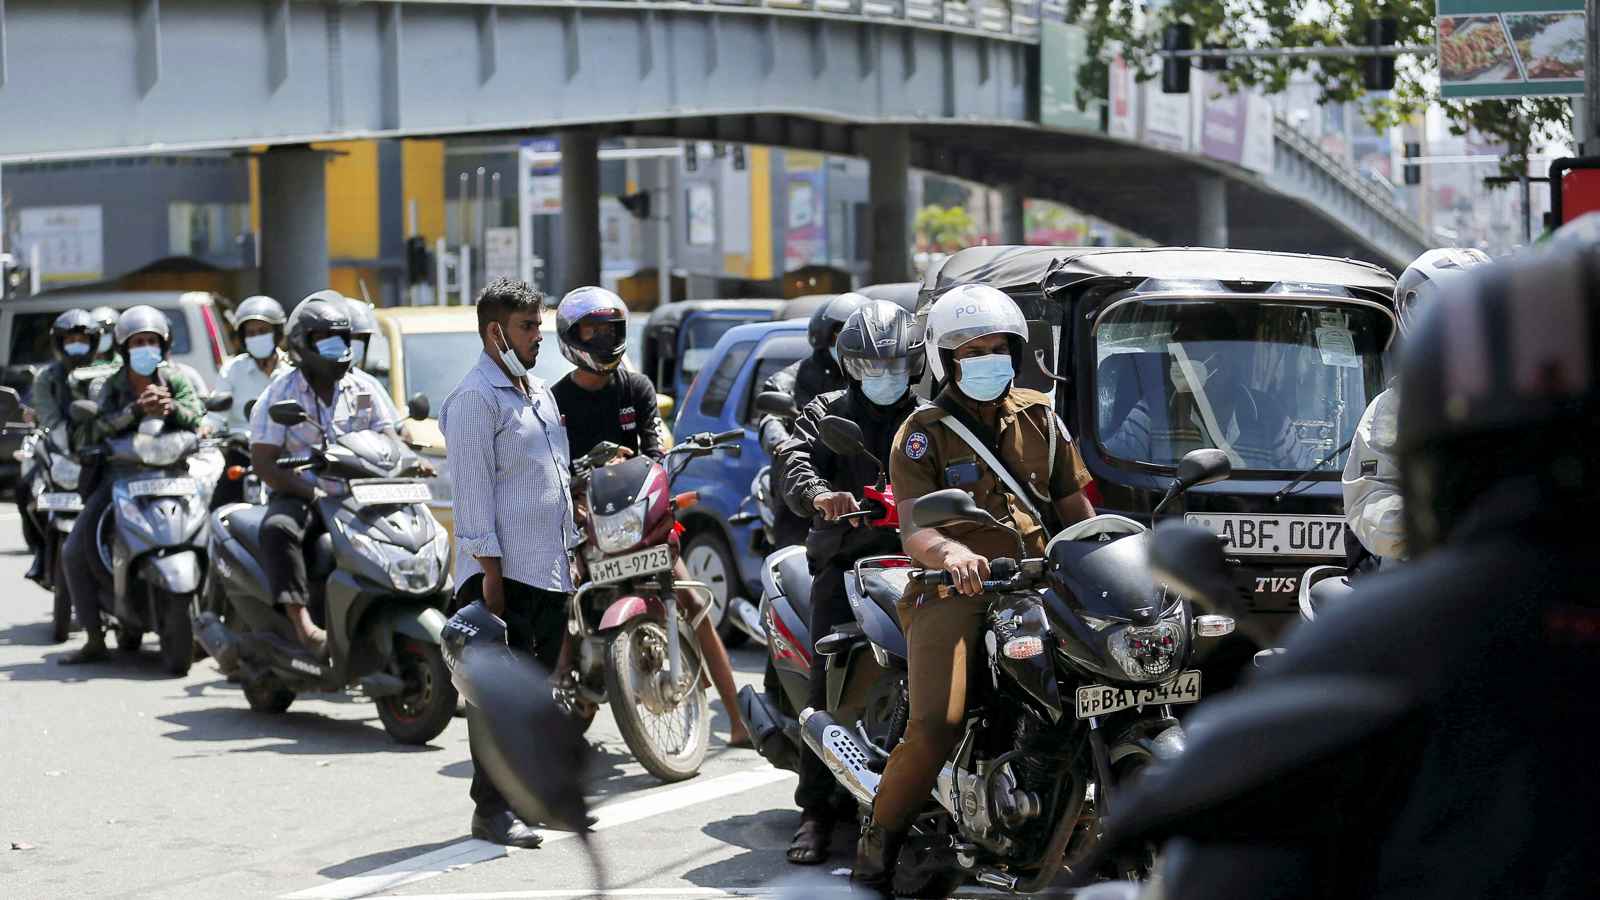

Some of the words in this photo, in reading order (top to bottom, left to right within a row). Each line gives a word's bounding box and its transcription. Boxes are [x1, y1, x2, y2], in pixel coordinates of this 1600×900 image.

[1221, 519, 1279, 549] ABF
[1289, 520, 1349, 551] 007
[1255, 577, 1297, 593] TVS
